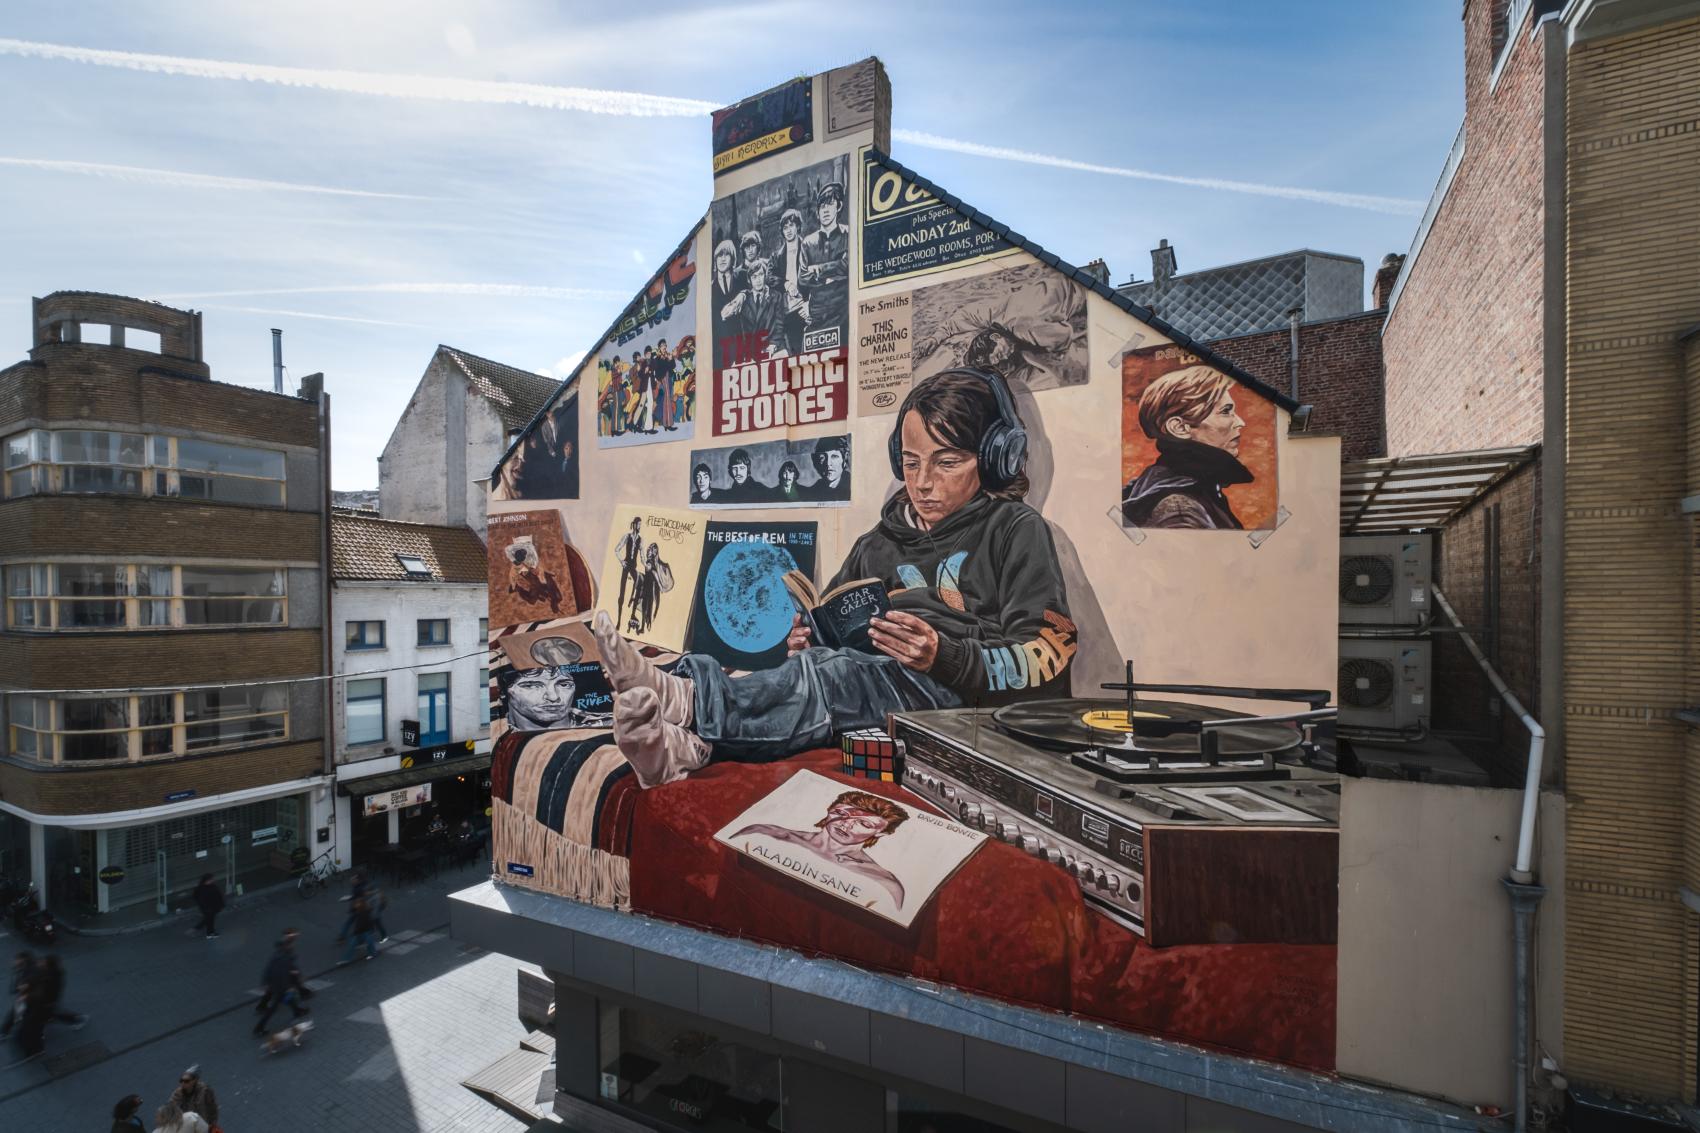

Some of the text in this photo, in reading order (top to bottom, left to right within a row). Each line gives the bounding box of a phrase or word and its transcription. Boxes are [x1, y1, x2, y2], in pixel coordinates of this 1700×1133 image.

[738, 134, 778, 159] HENDRIX
[912, 214, 927, 227] plus
[888, 223, 949, 251] MONDAY
[948, 217, 971, 236] 2nd
[865, 260, 884, 273] THE
[884, 247, 936, 268] WEDGEWOOD
[939, 238, 974, 255] ROOMS,
[860, 296, 909, 315] The Smiths
[872, 319, 893, 333] THIS
[805, 331, 838, 347] DECCA
[860, 327, 908, 347] CHARMING
[720, 328, 769, 368] THE
[873, 341, 895, 355] MAN
[870, 357, 884, 365] NEW
[886, 351, 911, 362] RELEASE
[722, 349, 844, 400] ROLLING
[721, 385, 834, 433] STONES
[707, 531, 724, 542] THE
[725, 531, 749, 543] BEST
[789, 532, 797, 540] IN
[798, 532, 814, 540] TIME
[840, 594, 878, 615] GAZER
[843, 587, 870, 605] STAR
[576, 694, 613, 709] RIVER
[405, 731, 415, 743] izy
[432, 751, 446, 759] izy
[917, 813, 979, 840] DAVID BOWIE
